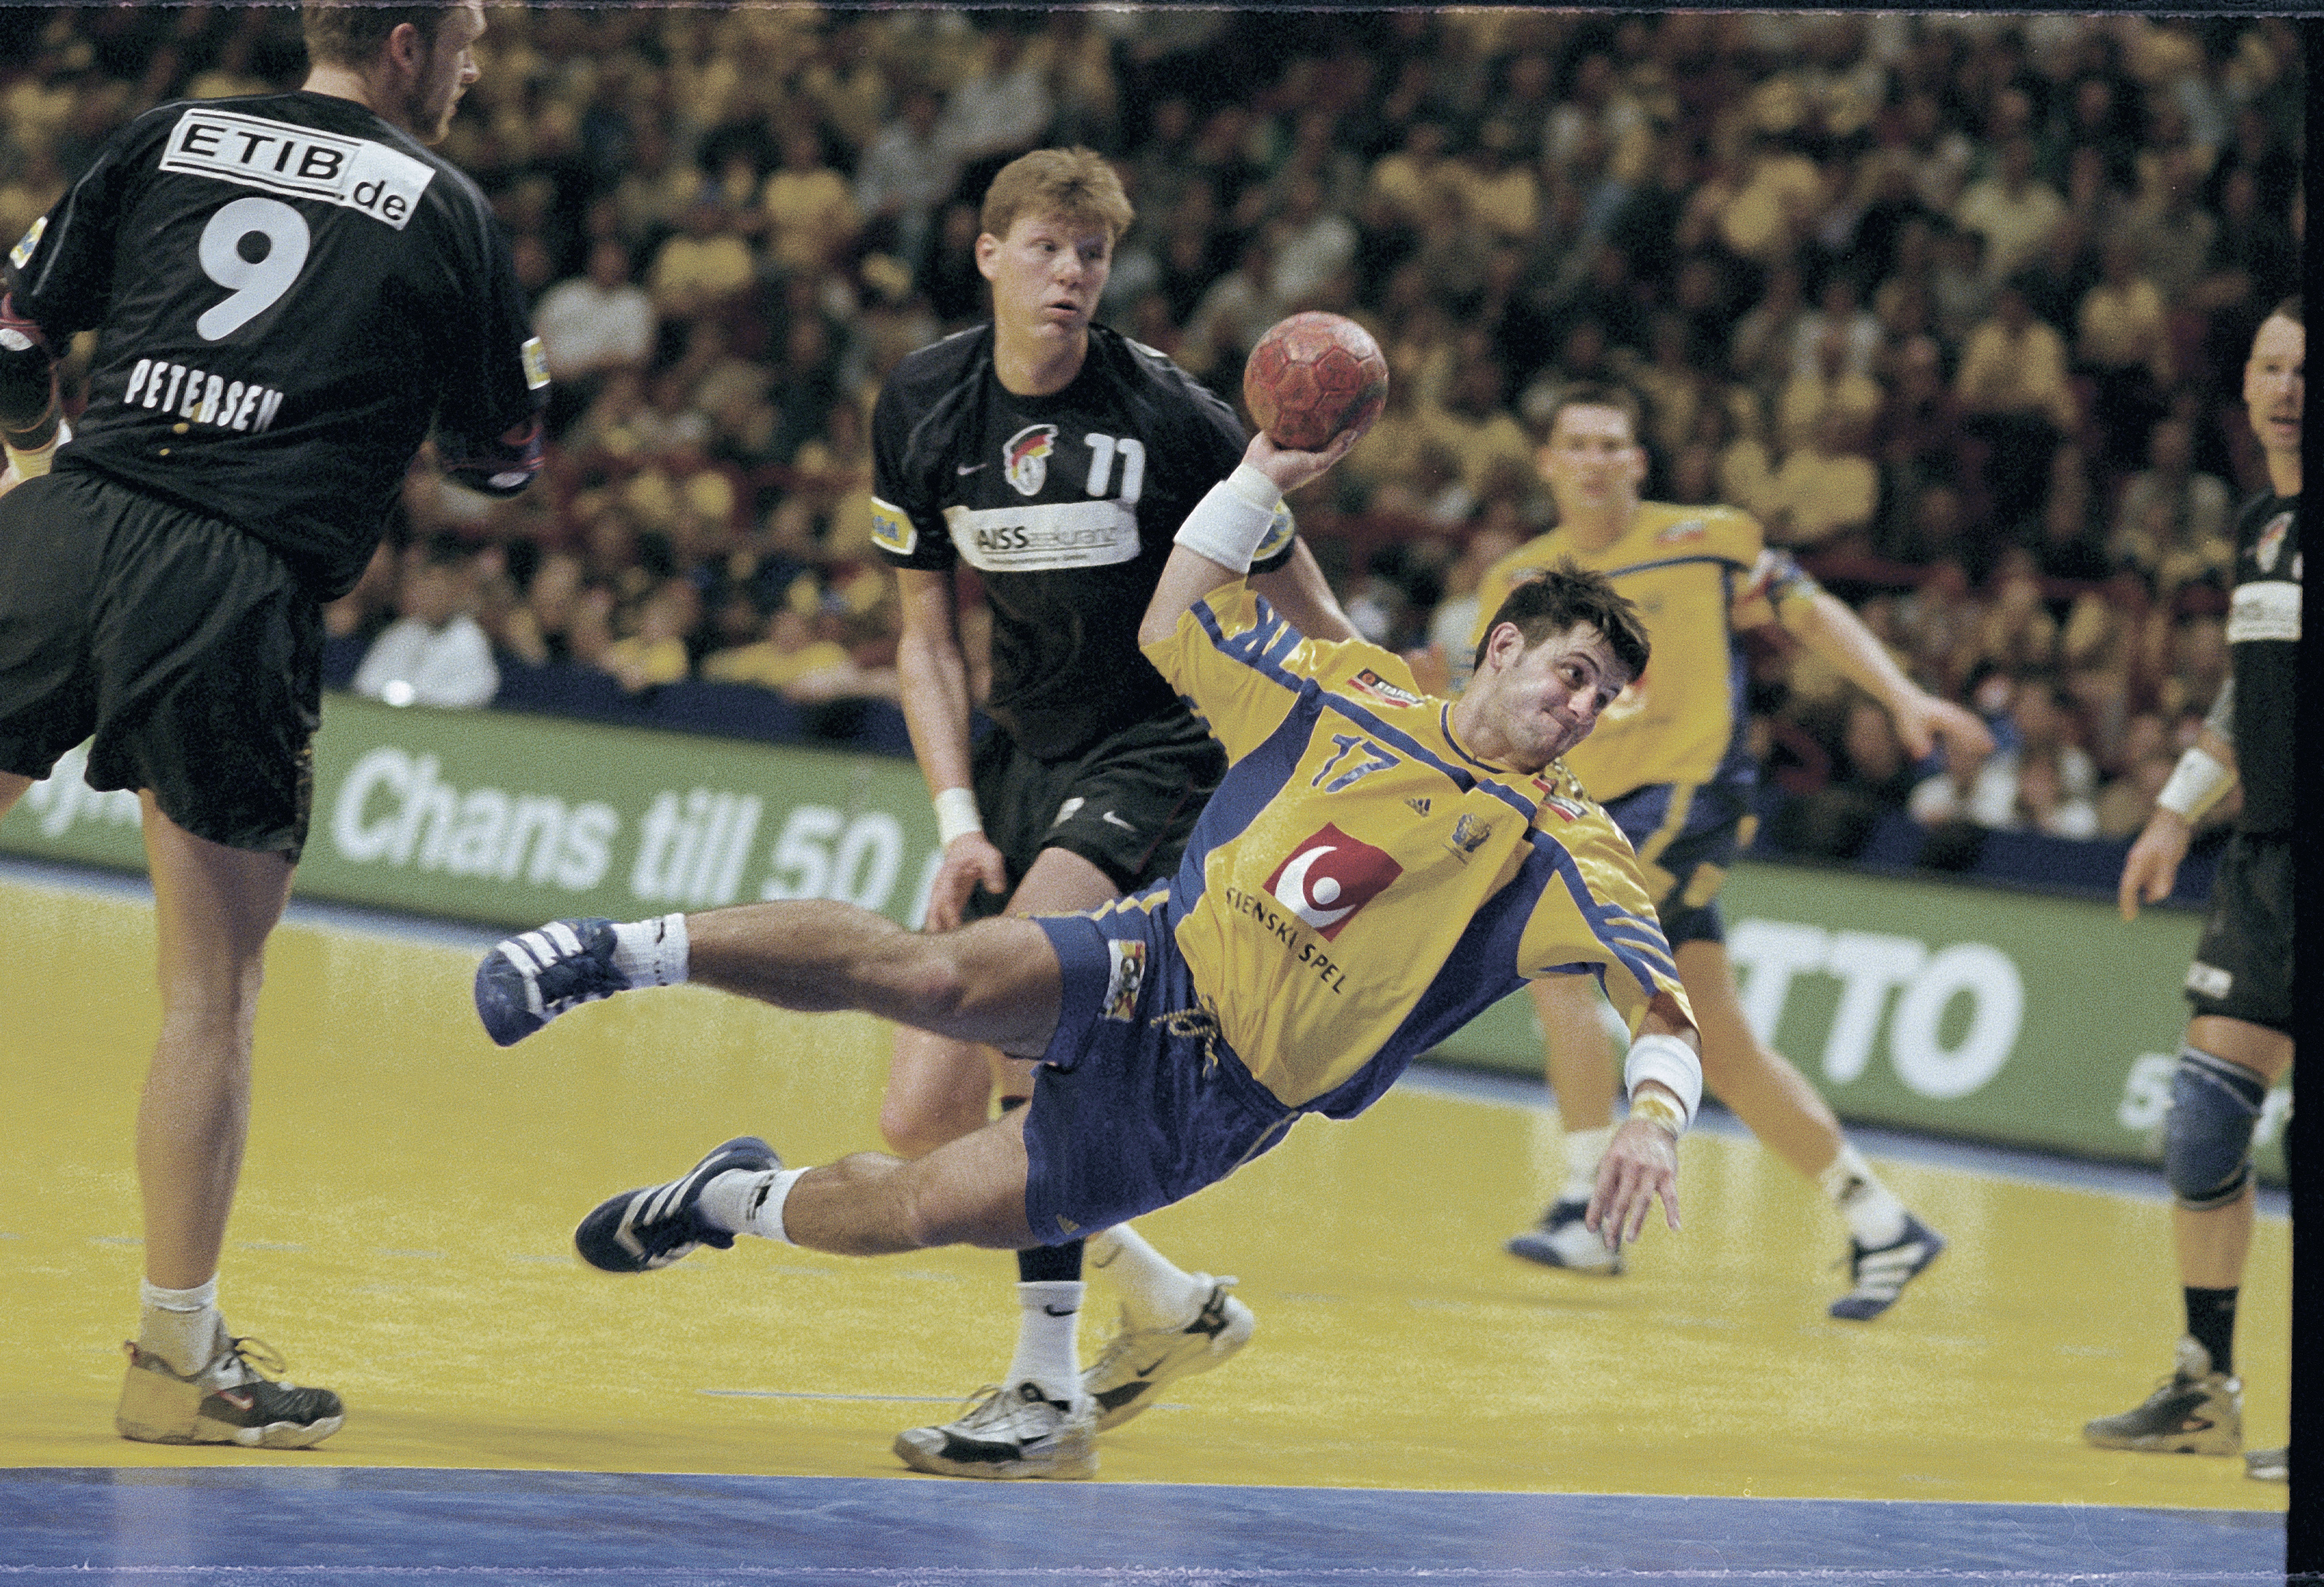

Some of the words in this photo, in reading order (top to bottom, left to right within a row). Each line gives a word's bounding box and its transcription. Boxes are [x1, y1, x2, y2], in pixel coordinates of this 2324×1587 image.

[197, 197, 311, 341] 9
[124, 359, 284, 432] PETERSEN
[1084, 433, 1145, 504] 11
[1311, 734, 1401, 793] 17
[333, 748, 619, 889] Chans
[631, 788, 763, 905] till
[761, 805, 903, 910] 50
[1298, 943, 1346, 995] SPEL
[1728, 919, 2024, 1099] TTO
